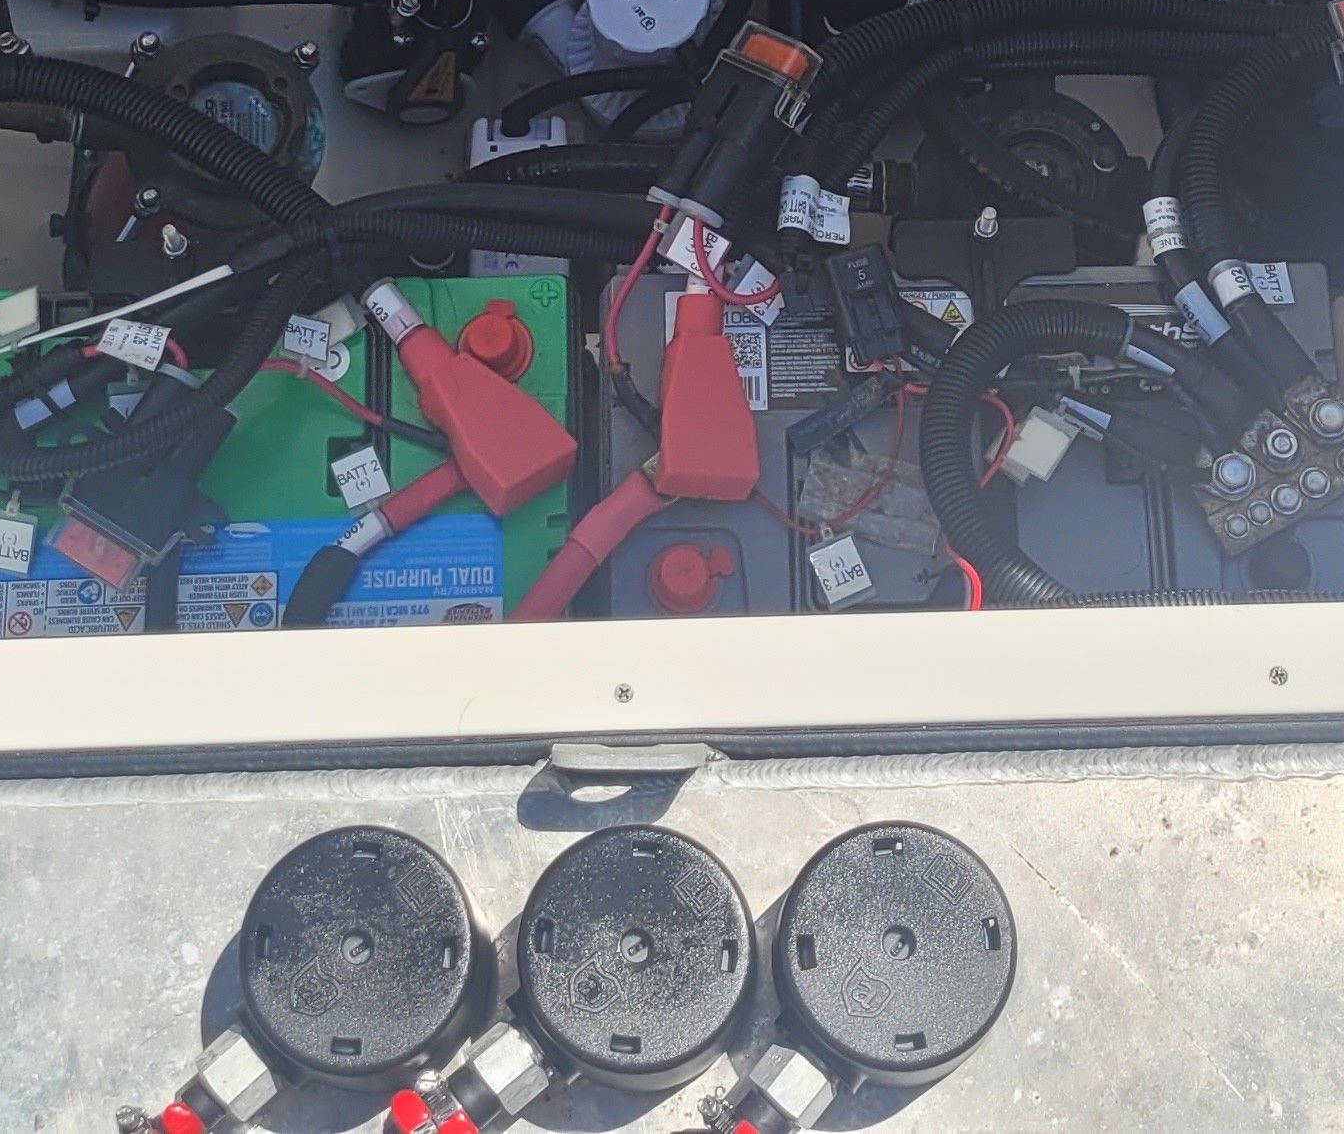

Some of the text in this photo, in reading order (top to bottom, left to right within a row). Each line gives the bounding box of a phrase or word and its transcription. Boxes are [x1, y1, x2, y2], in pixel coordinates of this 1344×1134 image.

[858, 269, 866, 280] 5
[1230, 268, 1250, 290] 102
[1265, 264, 1284, 303] BATT 3
[370, 301, 390, 323] 103
[286, 323, 328, 343] BATT 2
[337, 459, 382, 486] BATT 2
[362, 566, 494, 588] DUAL PURPOSE
[822, 564, 864, 592] BATT 3
[432, 585, 494, 596] MARINE/RV
[387, 605, 408, 616] MCA
[411, 604, 430, 615] 975
